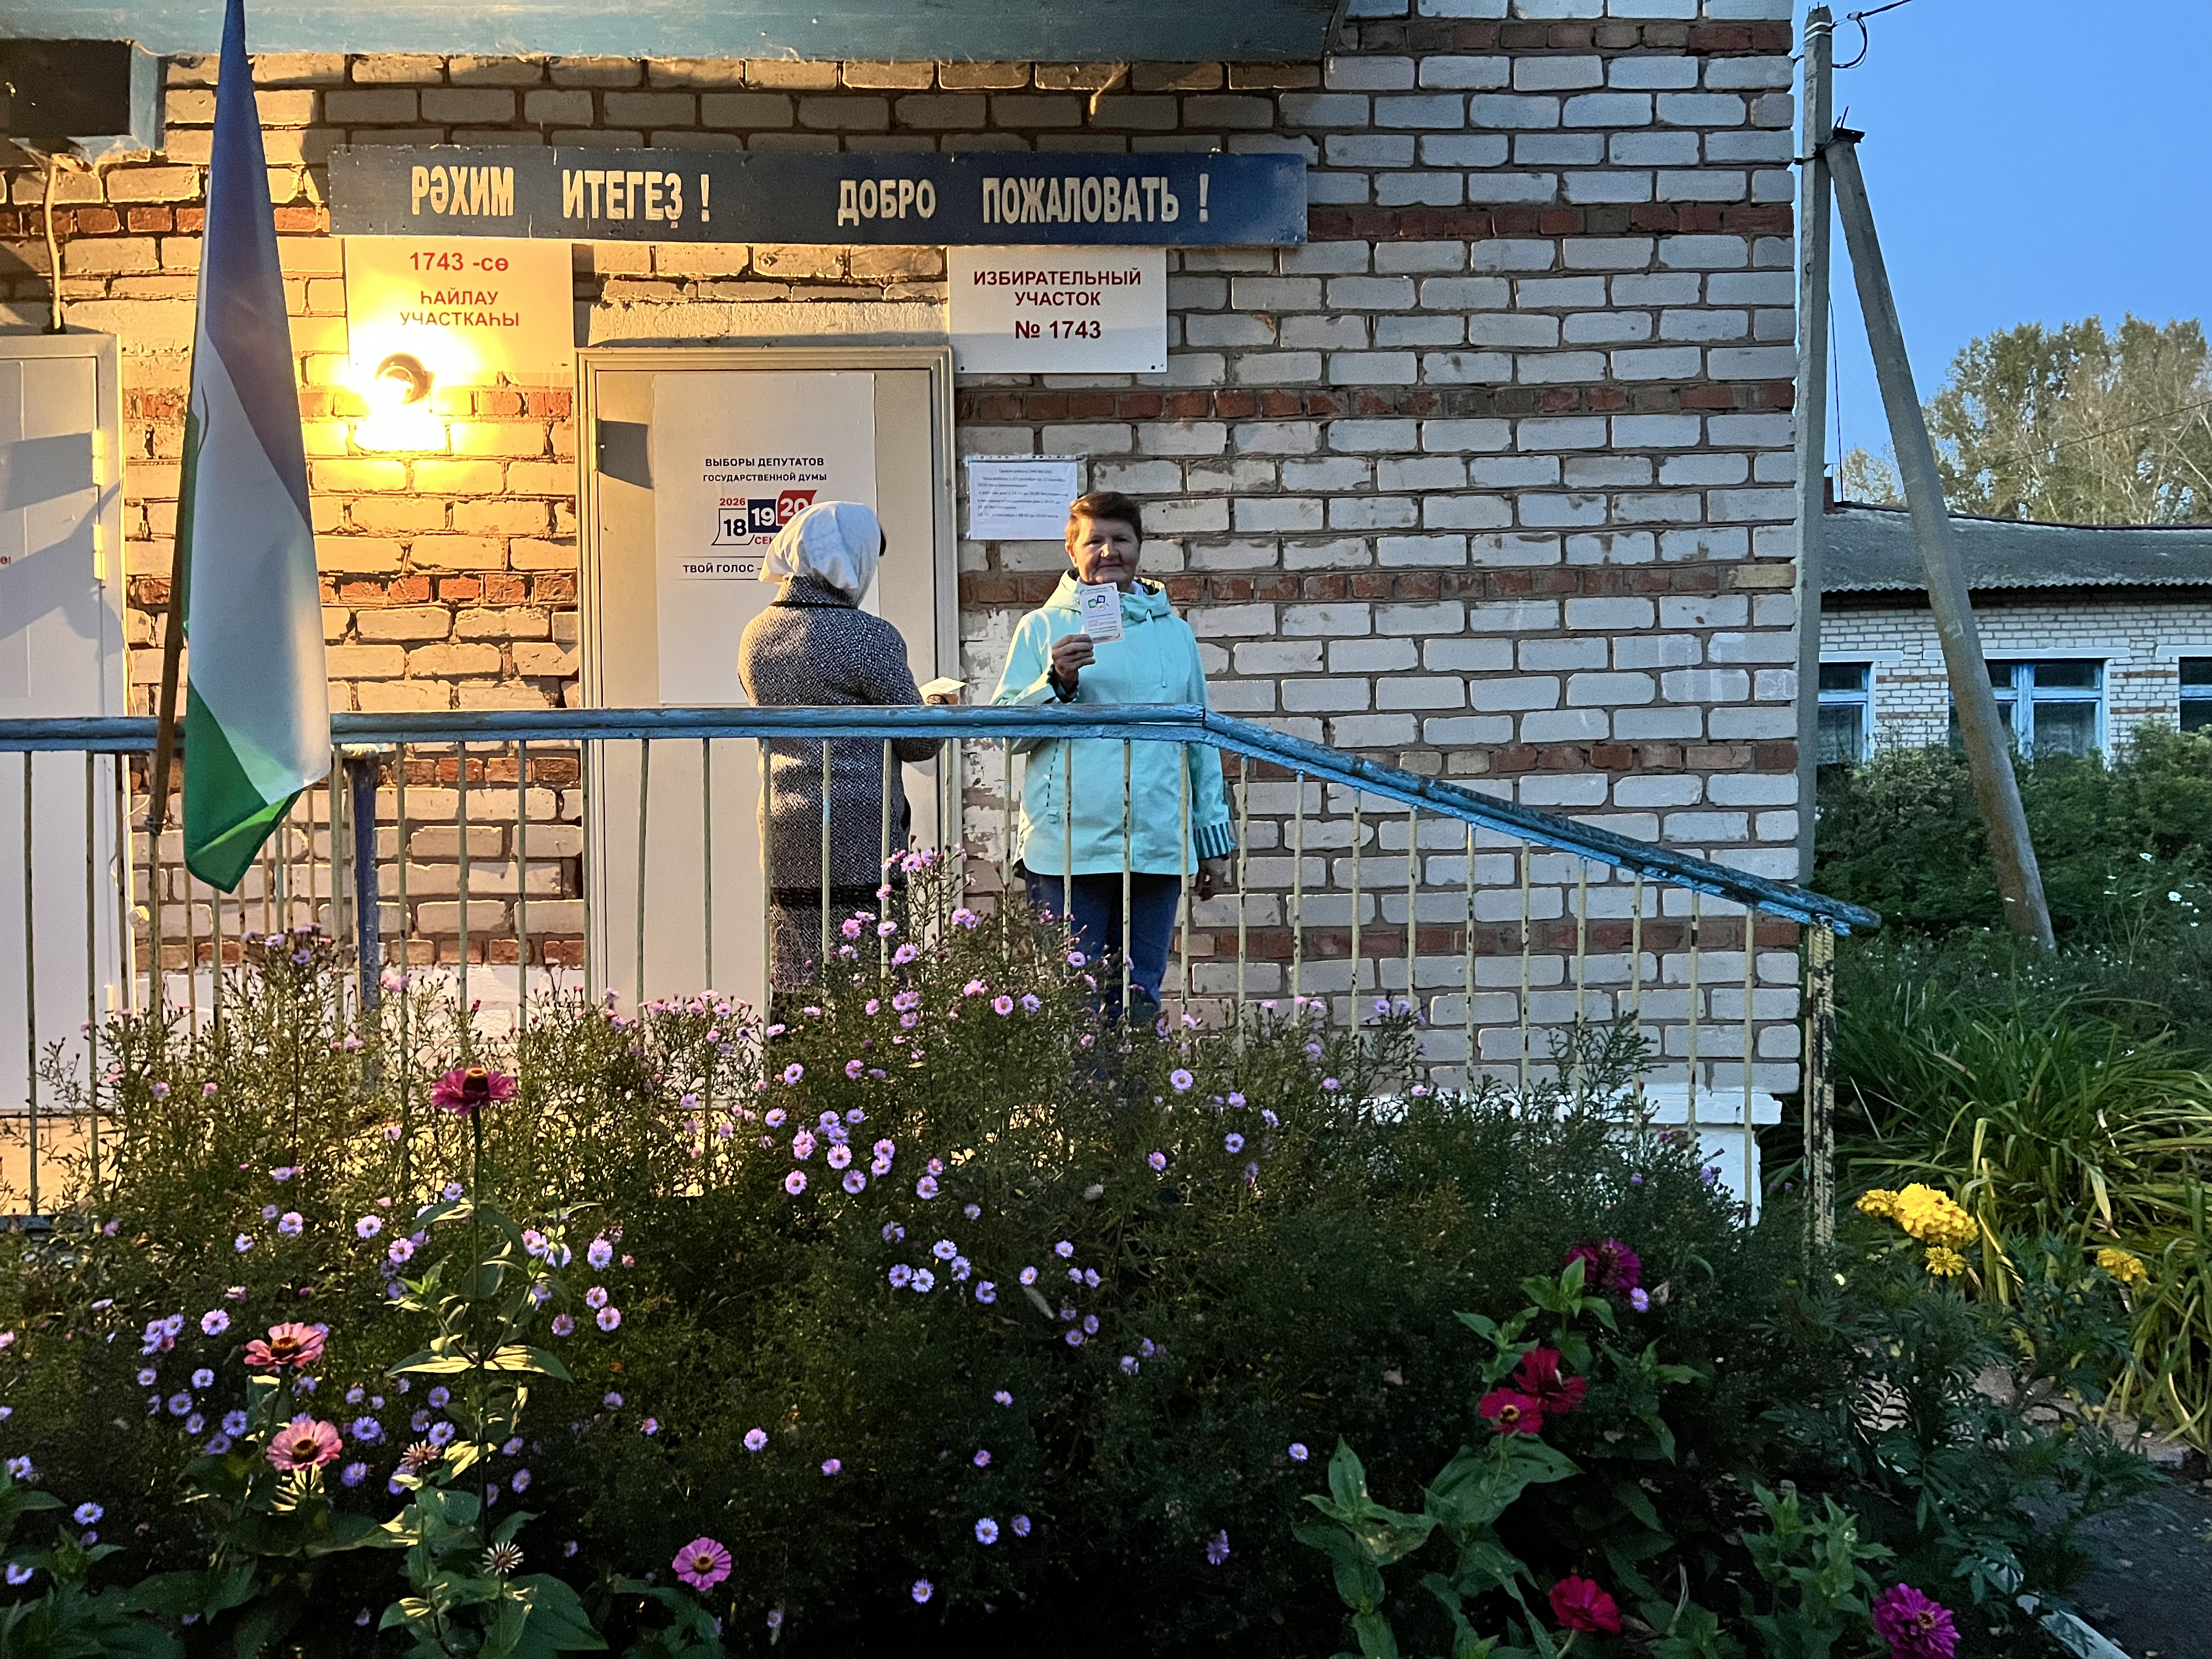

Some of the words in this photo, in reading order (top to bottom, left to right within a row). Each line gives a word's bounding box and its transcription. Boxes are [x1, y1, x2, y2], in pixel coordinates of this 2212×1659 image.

[411, 166, 514, 216] РӘХИМ
[562, 170, 682, 229] ИТЕГЕҘ
[838, 179, 935, 226] ДОБРО
[983, 177, 1178, 224] ПОЖАЛОВАТЬ
[410, 252, 463, 270] 1743
[974, 268, 1140, 285] ИЗБИРАТЕЛЬНЫЙ
[1015, 292, 1101, 306] УЧАСТОК
[1016, 321, 1040, 338] №
[1049, 321, 1101, 338] 1743
[758, 458, 823, 467] ДЕПУТАТОВ
[703, 472, 795, 482] ГОСУДАРСТВЕННОЙ
[724, 519, 746, 536] 18
[752, 507, 775, 526] 19
[780, 498, 809, 517] 20
[683, 563, 713, 572] ТВОЙ
